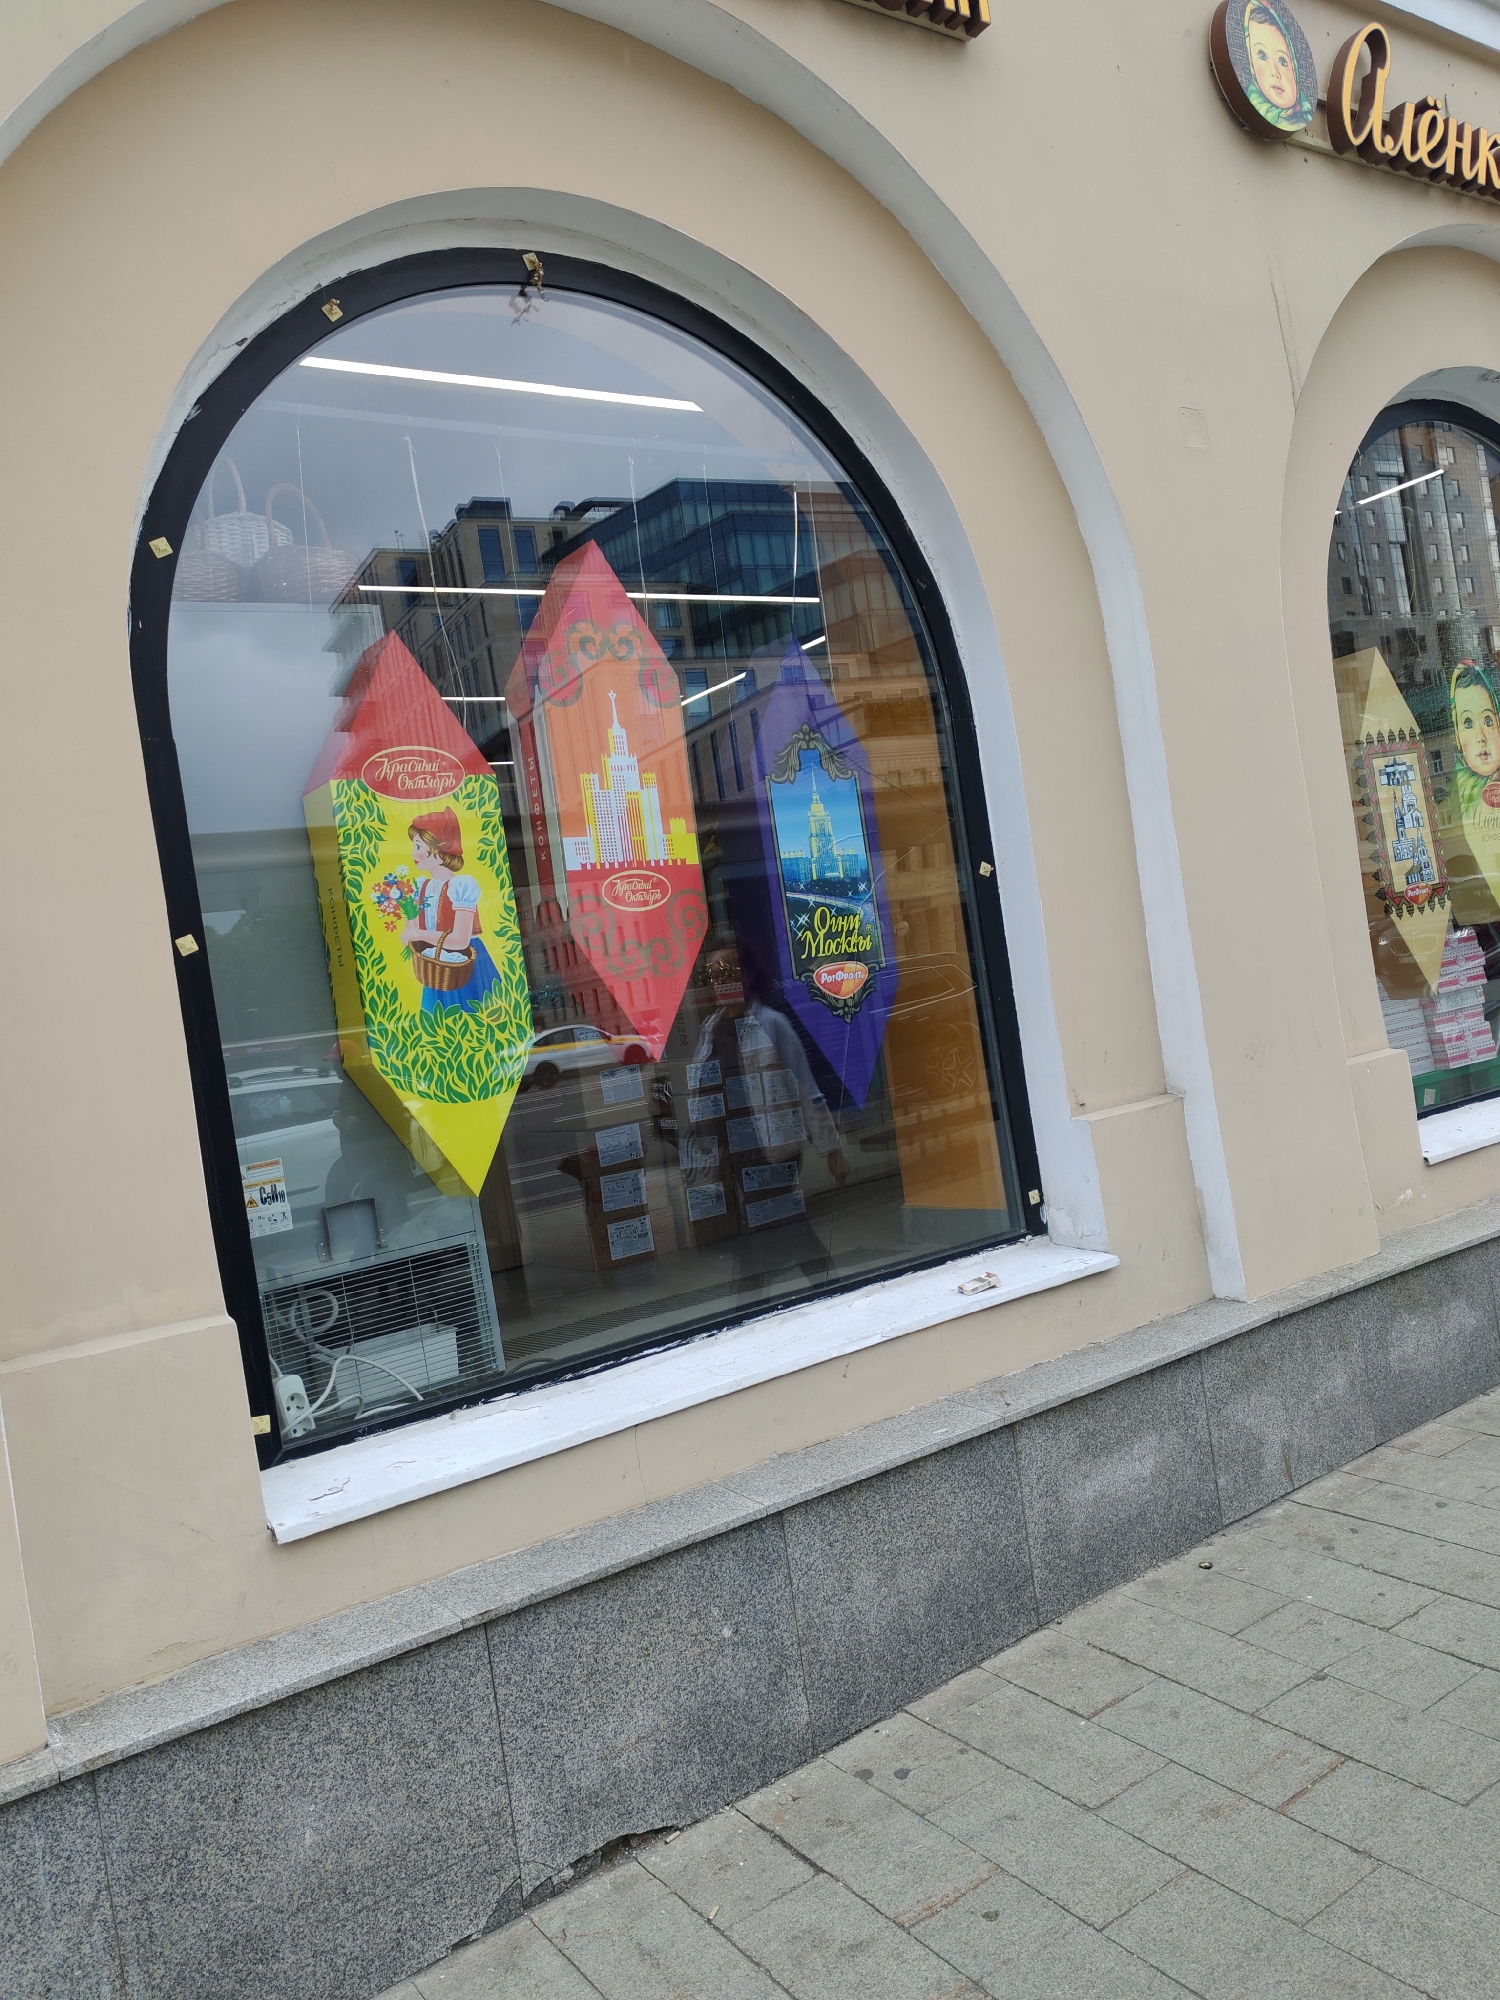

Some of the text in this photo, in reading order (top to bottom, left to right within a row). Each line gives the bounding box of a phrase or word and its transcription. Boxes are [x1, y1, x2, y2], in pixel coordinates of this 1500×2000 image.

[375, 756, 440, 781] Красный
[398, 772, 456, 795] Октябрь
[528, 757, 546, 860] КОНФЕТЫ
[1472, 802, 1500, 831] Алён
[612, 878, 653, 896] Красный
[626, 889, 662, 905] Октябрь
[328, 888, 344, 967] КОНФЕТЫ
[814, 906, 861, 934] Огни
[801, 930, 872, 959] Москвы
